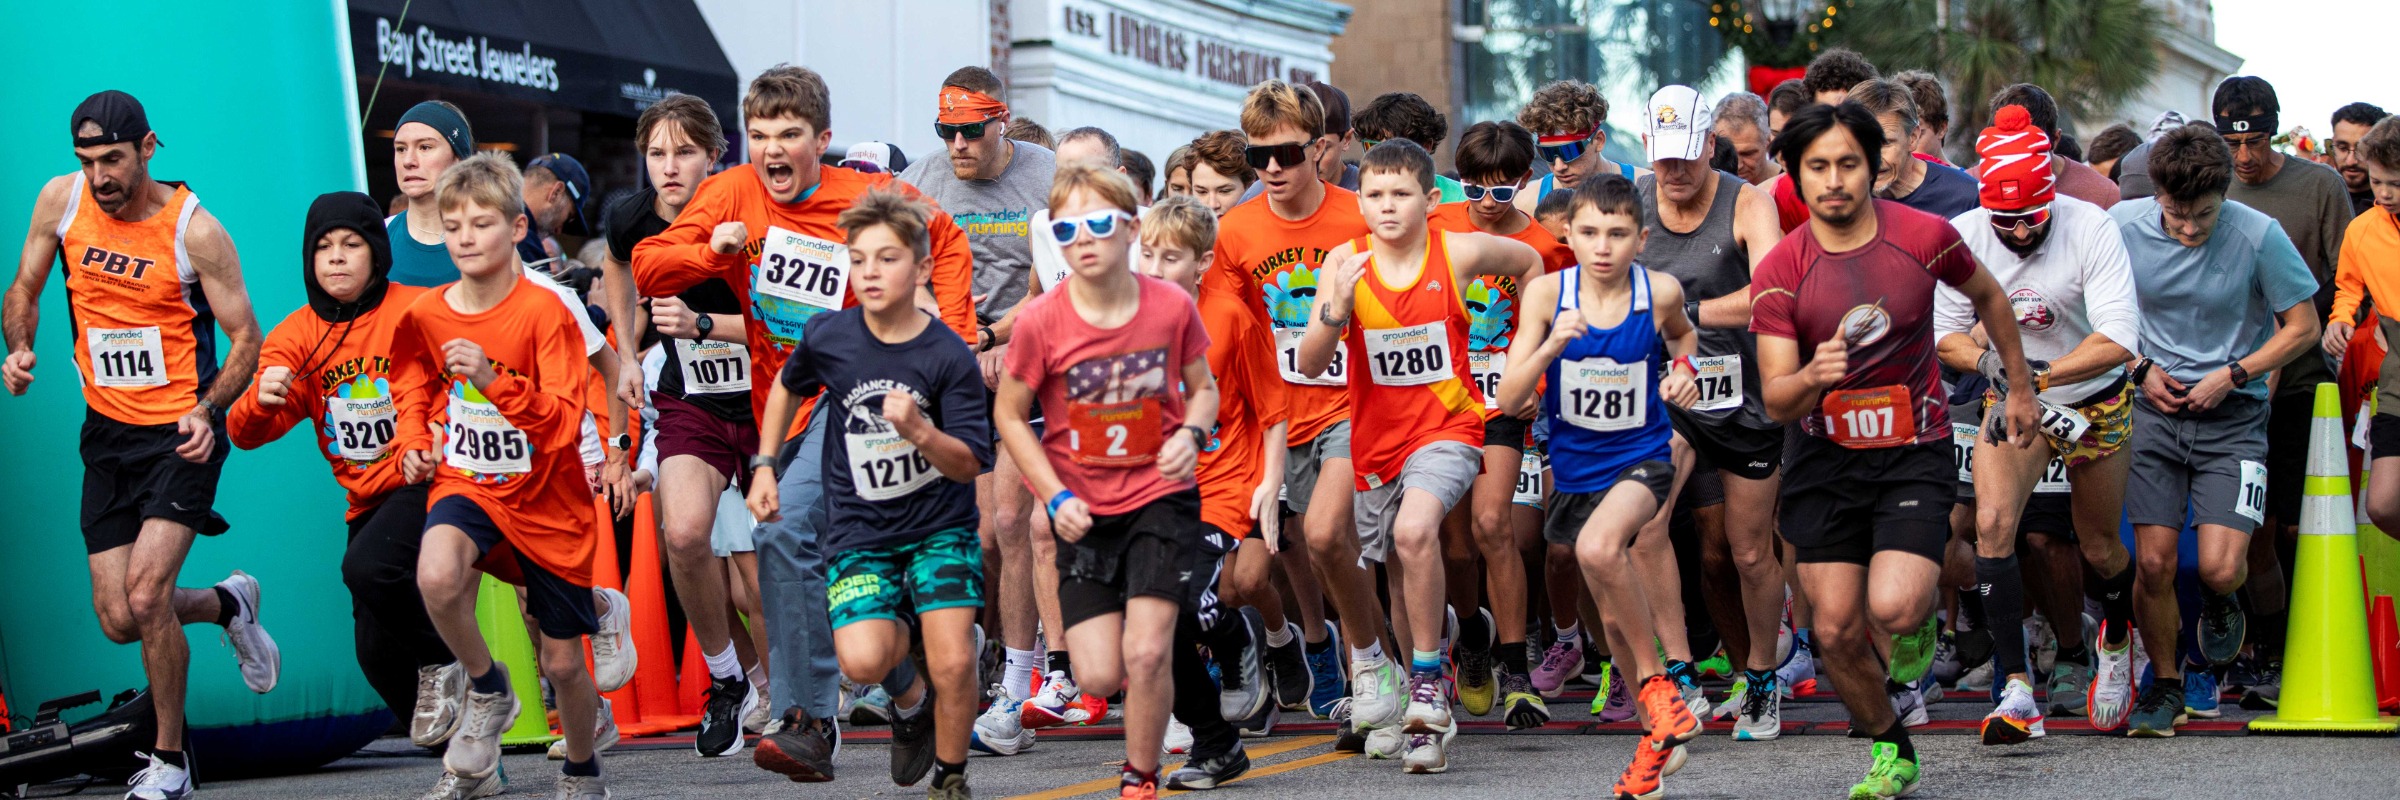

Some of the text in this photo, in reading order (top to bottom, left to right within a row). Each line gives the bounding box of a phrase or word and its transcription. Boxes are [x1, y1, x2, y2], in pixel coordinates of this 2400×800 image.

[376, 17, 560, 92] Bay Street Jewelers
[953, 207, 1028, 227] grounded
[968, 221, 1028, 237] running
[786, 236, 834, 252] grounded
[795, 245, 832, 261] running
[81, 245, 156, 280] PBT
[1252, 247, 1305, 281] TURKEY
[766, 253, 841, 297] 3276
[101, 330, 143, 342] grounded
[781, 326, 795, 335] DAY
[1382, 326, 1428, 342] grounded
[111, 339, 144, 347] running
[689, 341, 729, 351] grounded
[1393, 334, 1429, 346] running
[698, 347, 732, 356] running
[1468, 353, 1490, 362] nded
[100, 350, 154, 377] 1114
[1373, 344, 1443, 377] 1280
[1697, 358, 1724, 368] unded
[321, 357, 366, 391] URKEY
[689, 357, 744, 385] 1077
[1579, 367, 1629, 378] grounded
[1700, 365, 1725, 373] nning
[1471, 372, 1502, 399] 56
[1589, 375, 1629, 385] running
[842, 380, 895, 409] RADIANCE
[912, 391, 932, 409] RUN
[1694, 375, 1733, 402] 174
[346, 397, 392, 412] grounded
[1569, 387, 1636, 420] 1281
[1851, 396, 1892, 407] running
[357, 404, 393, 416] running
[1101, 410, 1143, 422] running
[467, 415, 505, 427] running
[1841, 406, 1894, 438] 107
[2041, 408, 2076, 439] 73
[339, 414, 398, 450] 320
[1953, 426, 1978, 435] round
[454, 422, 524, 462] 2985
[876, 440, 912, 453] runnin
[1106, 424, 1128, 456] 2
[861, 448, 932, 489] 1276
[1516, 471, 1540, 495] 91
